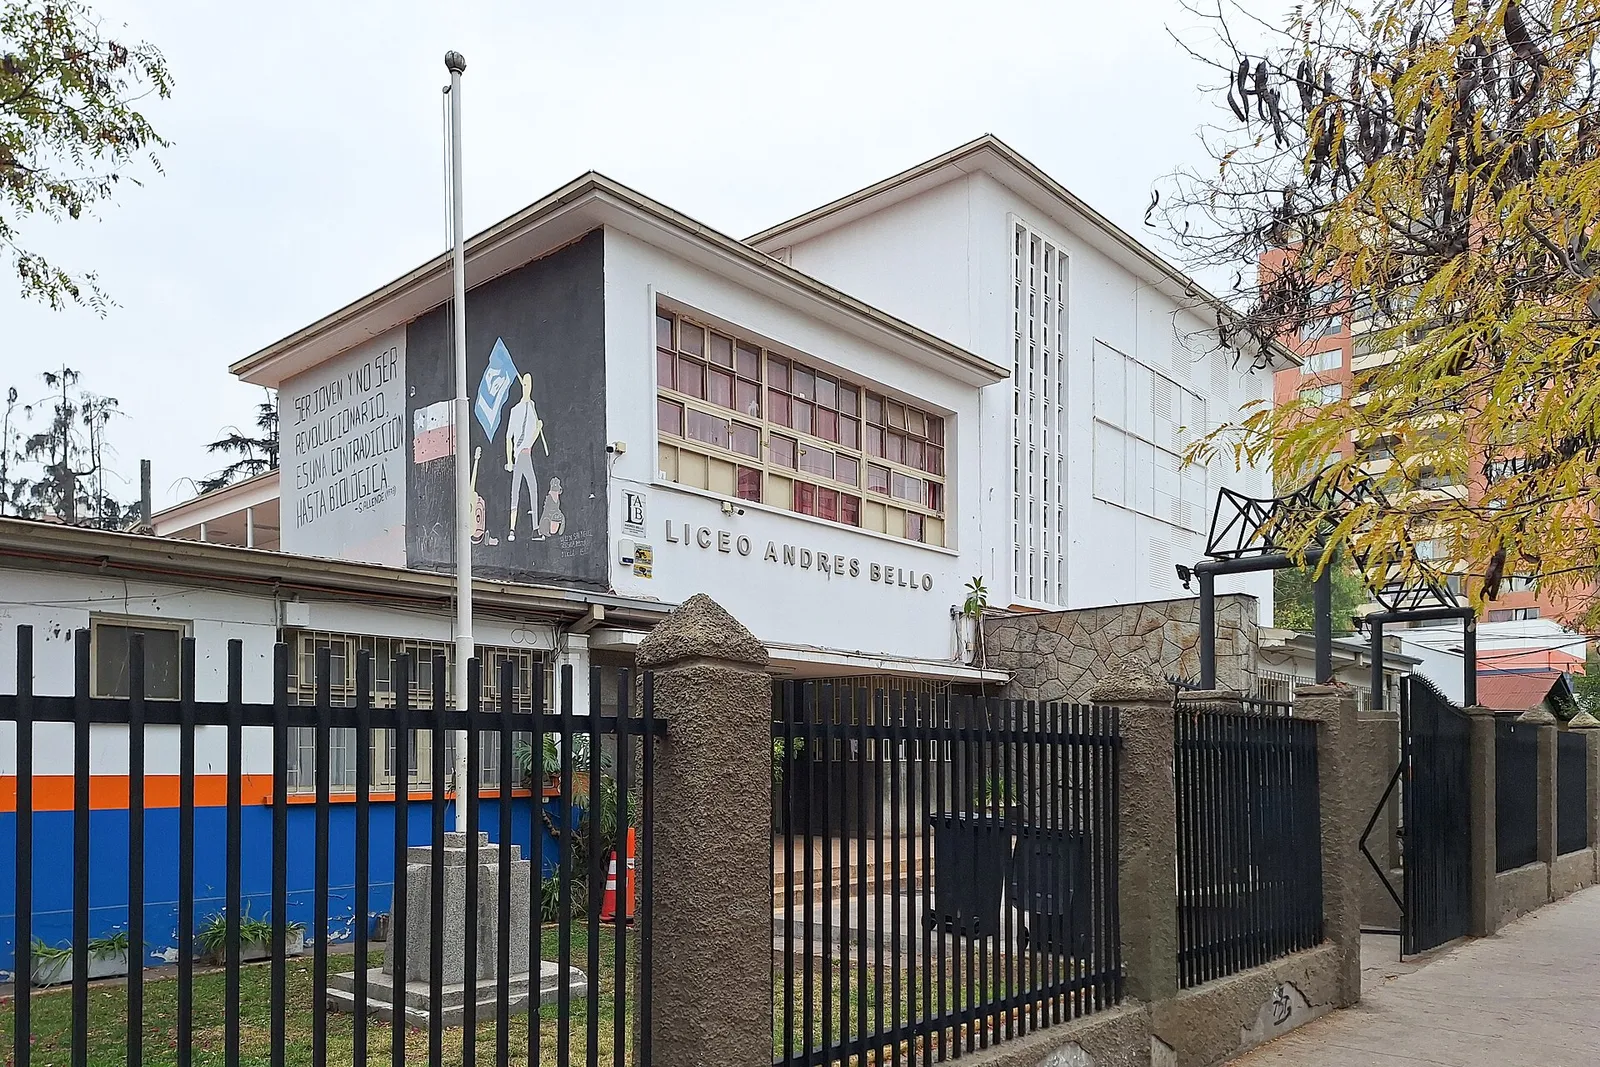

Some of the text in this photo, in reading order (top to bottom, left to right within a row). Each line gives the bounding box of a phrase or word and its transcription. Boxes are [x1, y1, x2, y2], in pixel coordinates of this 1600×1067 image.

[313, 379, 343, 415] JOVEN
[375, 346, 398, 388] SER
[296, 488, 327, 529] HASTA
[665, 519, 752, 556] LICEO
[764, 541, 860, 578] ANDRES
[870, 562, 933, 592] BELLO
